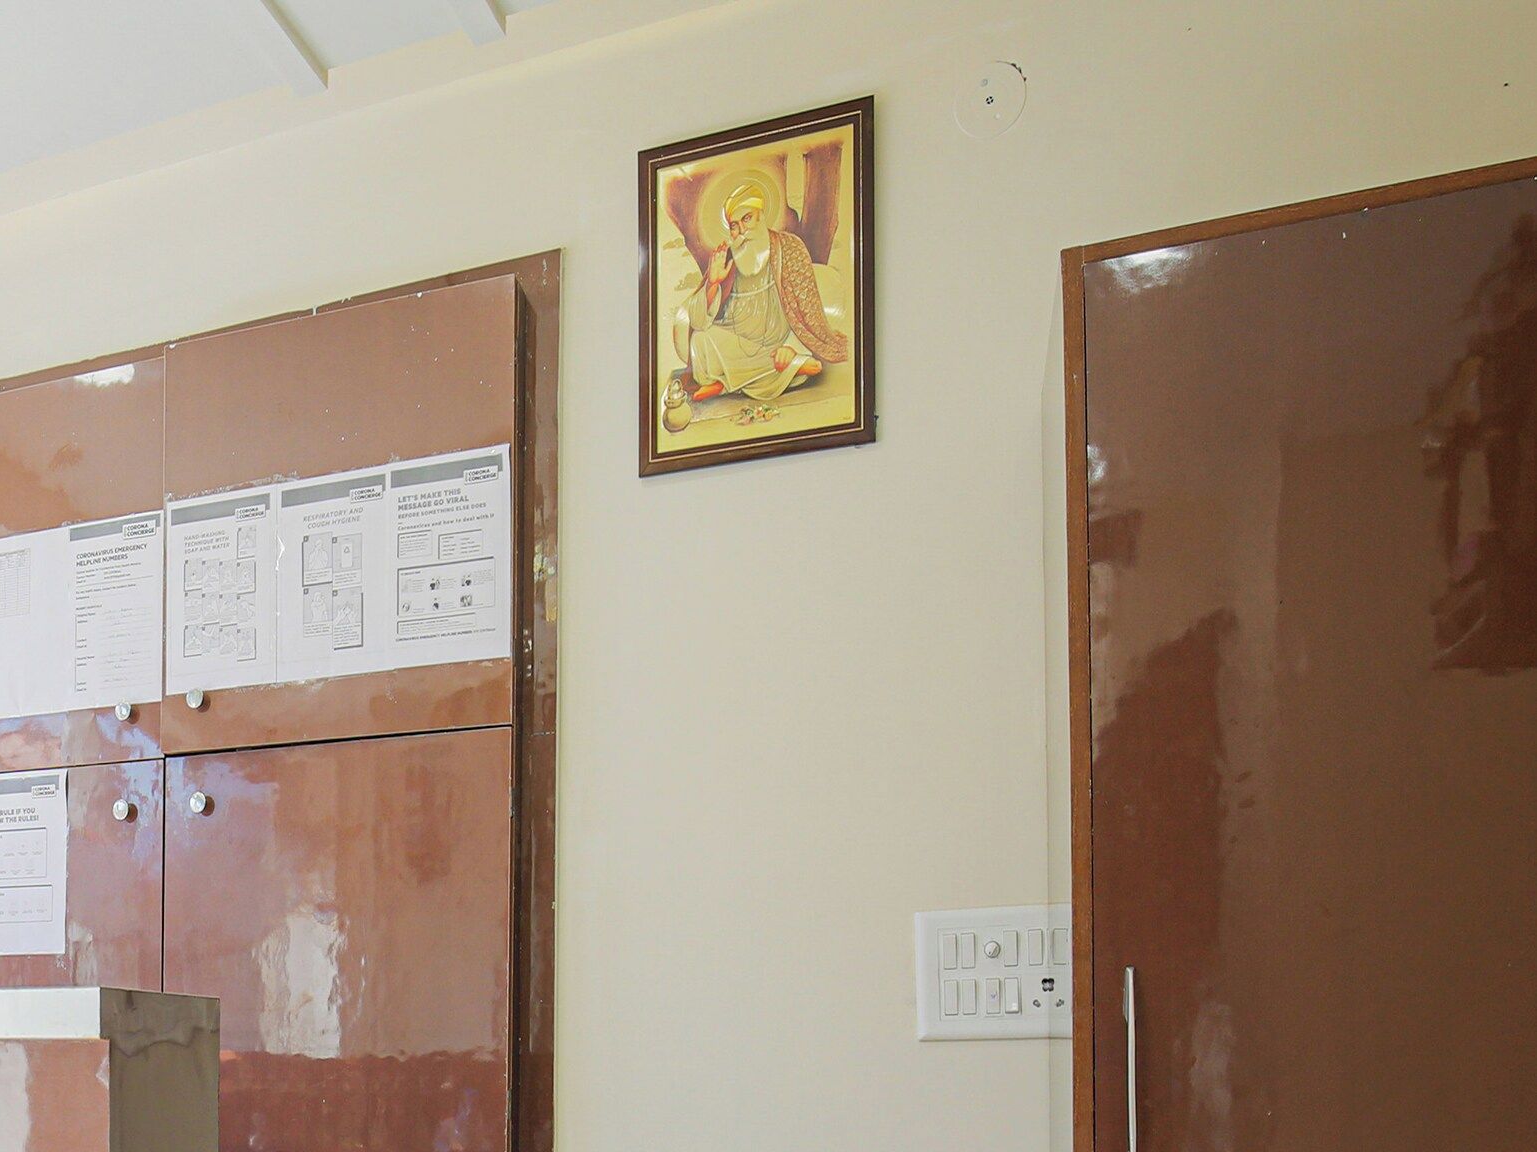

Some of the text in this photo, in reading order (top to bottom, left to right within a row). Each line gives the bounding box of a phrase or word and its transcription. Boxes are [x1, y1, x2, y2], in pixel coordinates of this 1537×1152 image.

[398, 488, 461, 503] LET'S MAKE THIS
[398, 495, 469, 511] MESSAGE GO VIRAL
[303, 507, 364, 522] RESPIRATORY AND
[398, 511, 419, 519] BEFORE
[420, 506, 454, 516] SOMETHING
[307, 515, 361, 529] COUGH HYGIENE
[76, 543, 148, 560] CORONAVIRUS EMERGENCY
[76, 553, 128, 567] HELPLINE NUMBERS
